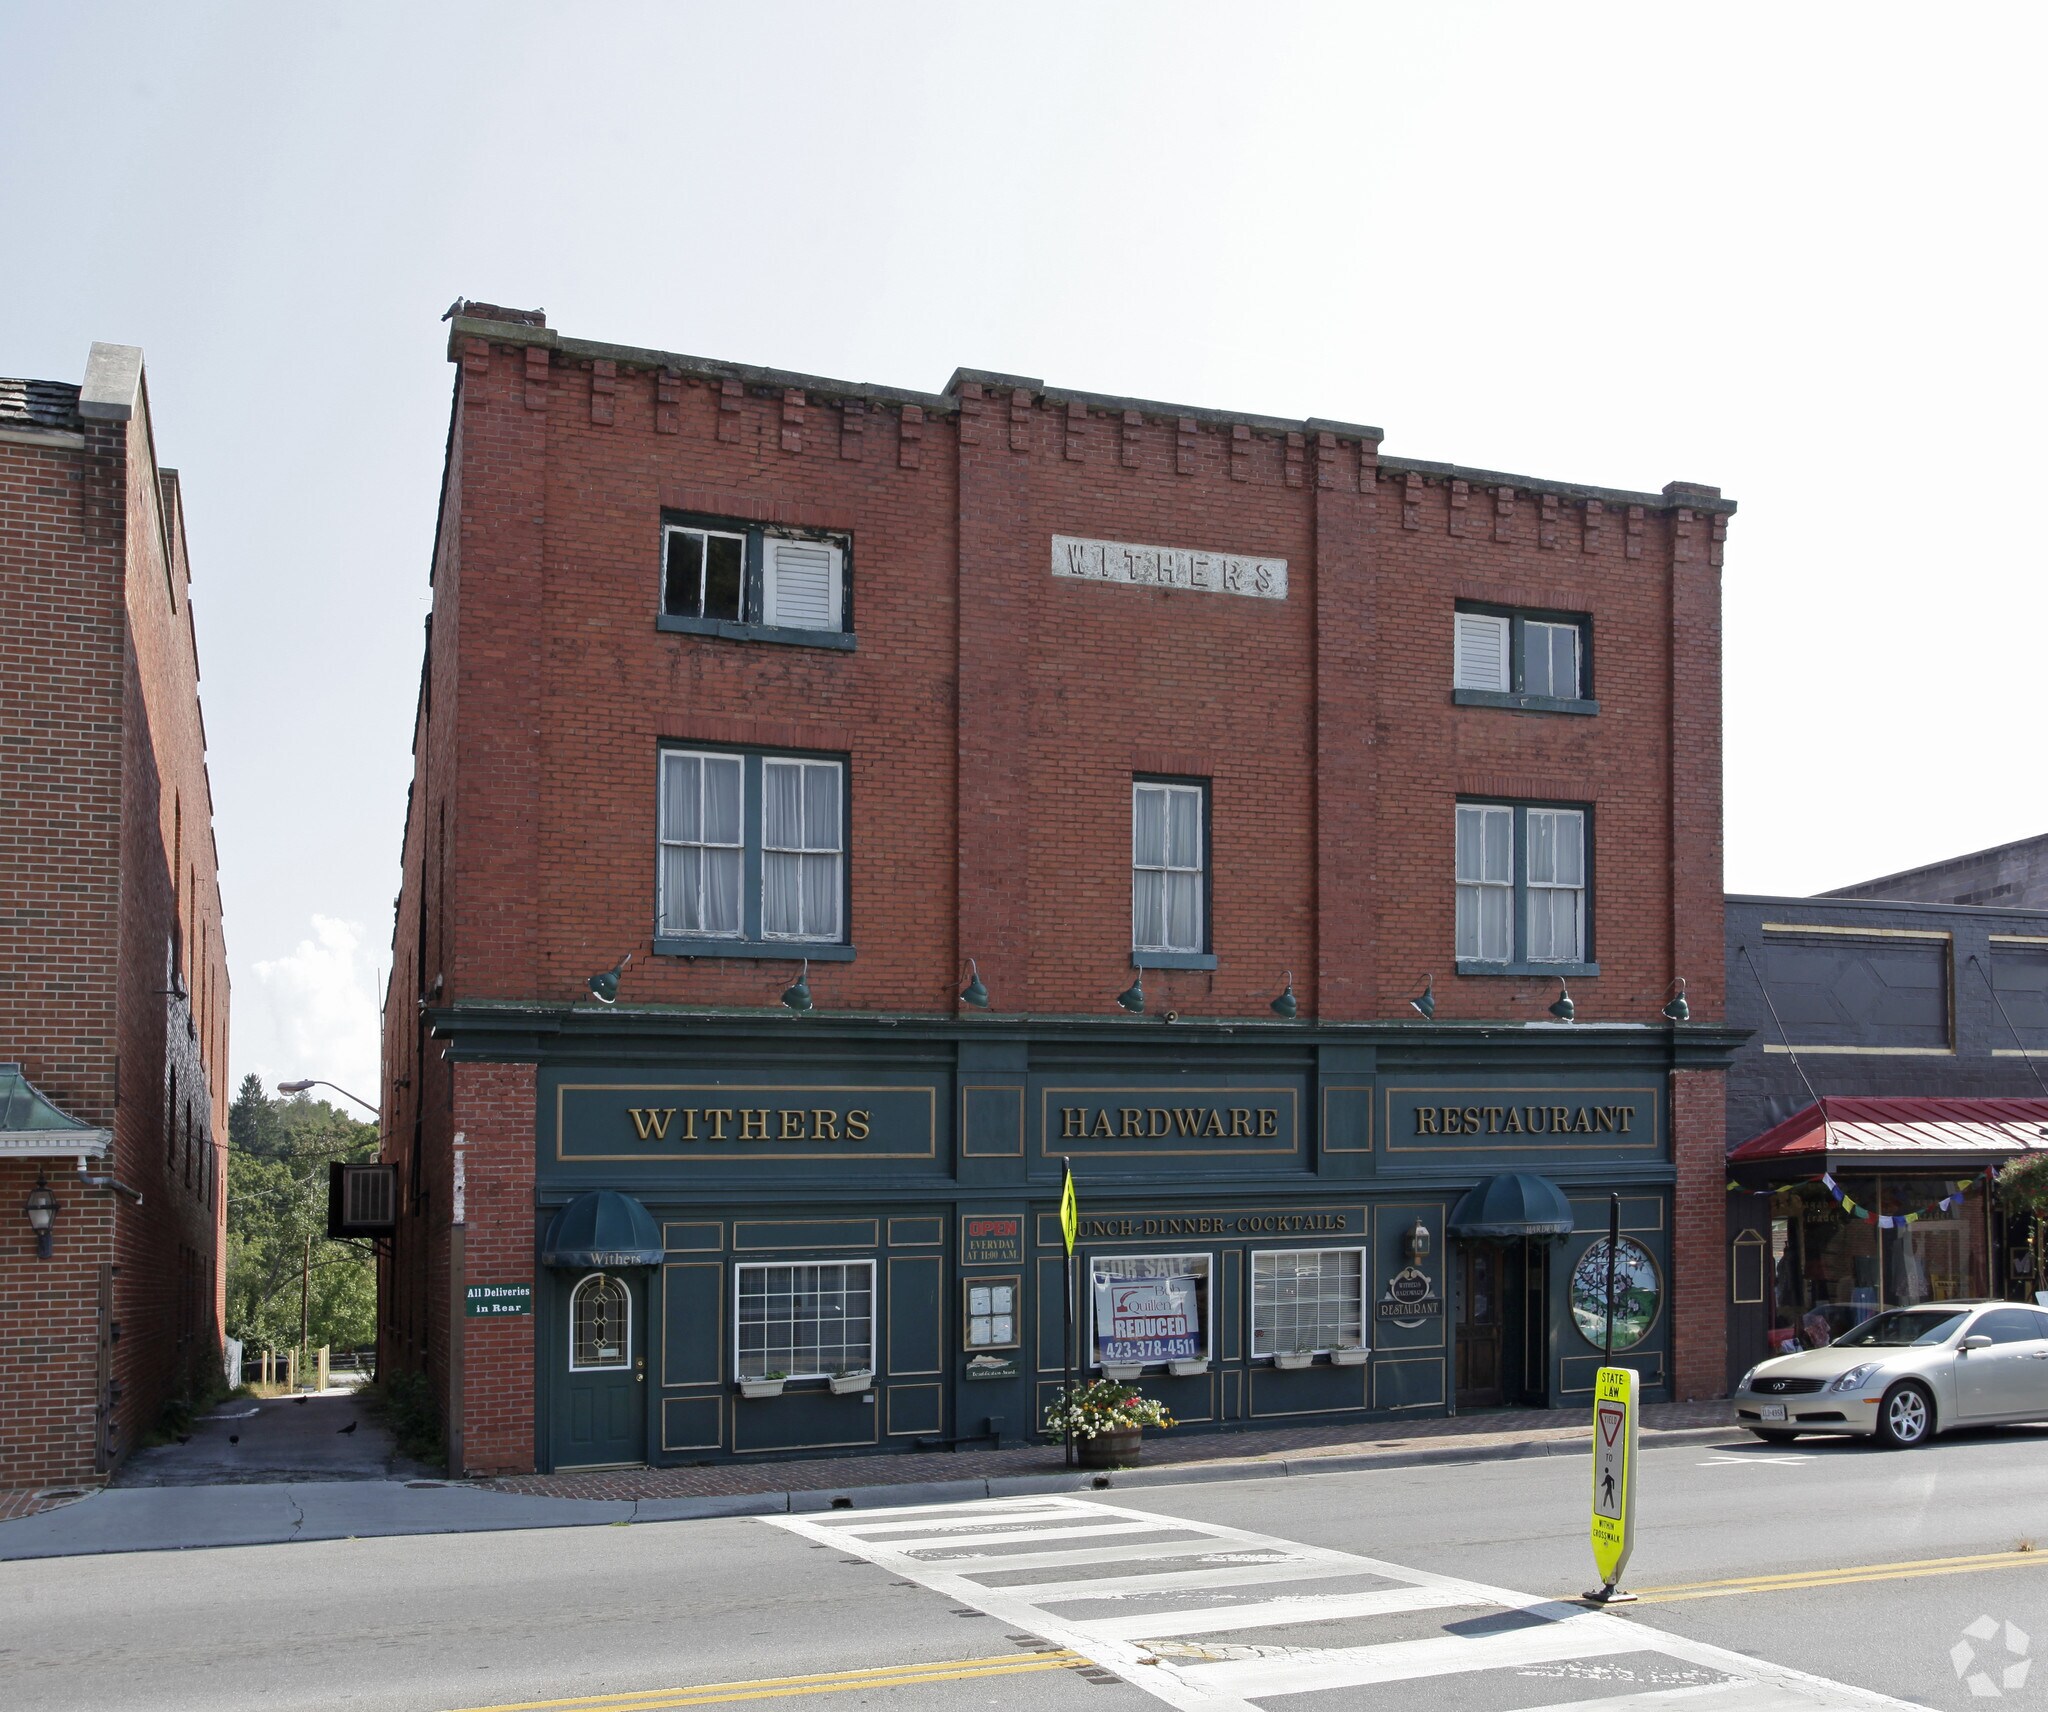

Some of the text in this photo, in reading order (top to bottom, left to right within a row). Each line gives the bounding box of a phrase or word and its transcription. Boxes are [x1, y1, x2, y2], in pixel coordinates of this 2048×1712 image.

[1067, 543, 1274, 593] WITHERS
[627, 1107, 872, 1141] WITHERS
[1061, 1106, 1280, 1139] HARDWARE
[1415, 1105, 1636, 1135] RESTAURANT
[968, 1220, 1017, 1237] OPEN
[970, 1239, 1016, 1250] EVERYDAY
[590, 1252, 642, 1265] Withers
[967, 1250, 977, 1260] AT
[1102, 1257, 1188, 1279] FOR SALE
[467, 1286, 530, 1298] All Deliveries
[1155, 1284, 1181, 1297] Bob
[476, 1303, 522, 1313] in Rear
[1128, 1299, 1172, 1314] Quillen
[1381, 1302, 1439, 1316] RESTAURANT
[1115, 1317, 1186, 1338] REDUCED
[1106, 1339, 1195, 1358] 423-378-4511
[1601, 1372, 1624, 1385] STATE
[1603, 1385, 1619, 1398] LAW
[1604, 1414, 1617, 1425] YIELD
[1605, 1453, 1613, 1462] TO
[1599, 1519, 1615, 1531] WITHIN
[1593, 1528, 1620, 1543] CROSSWALK
